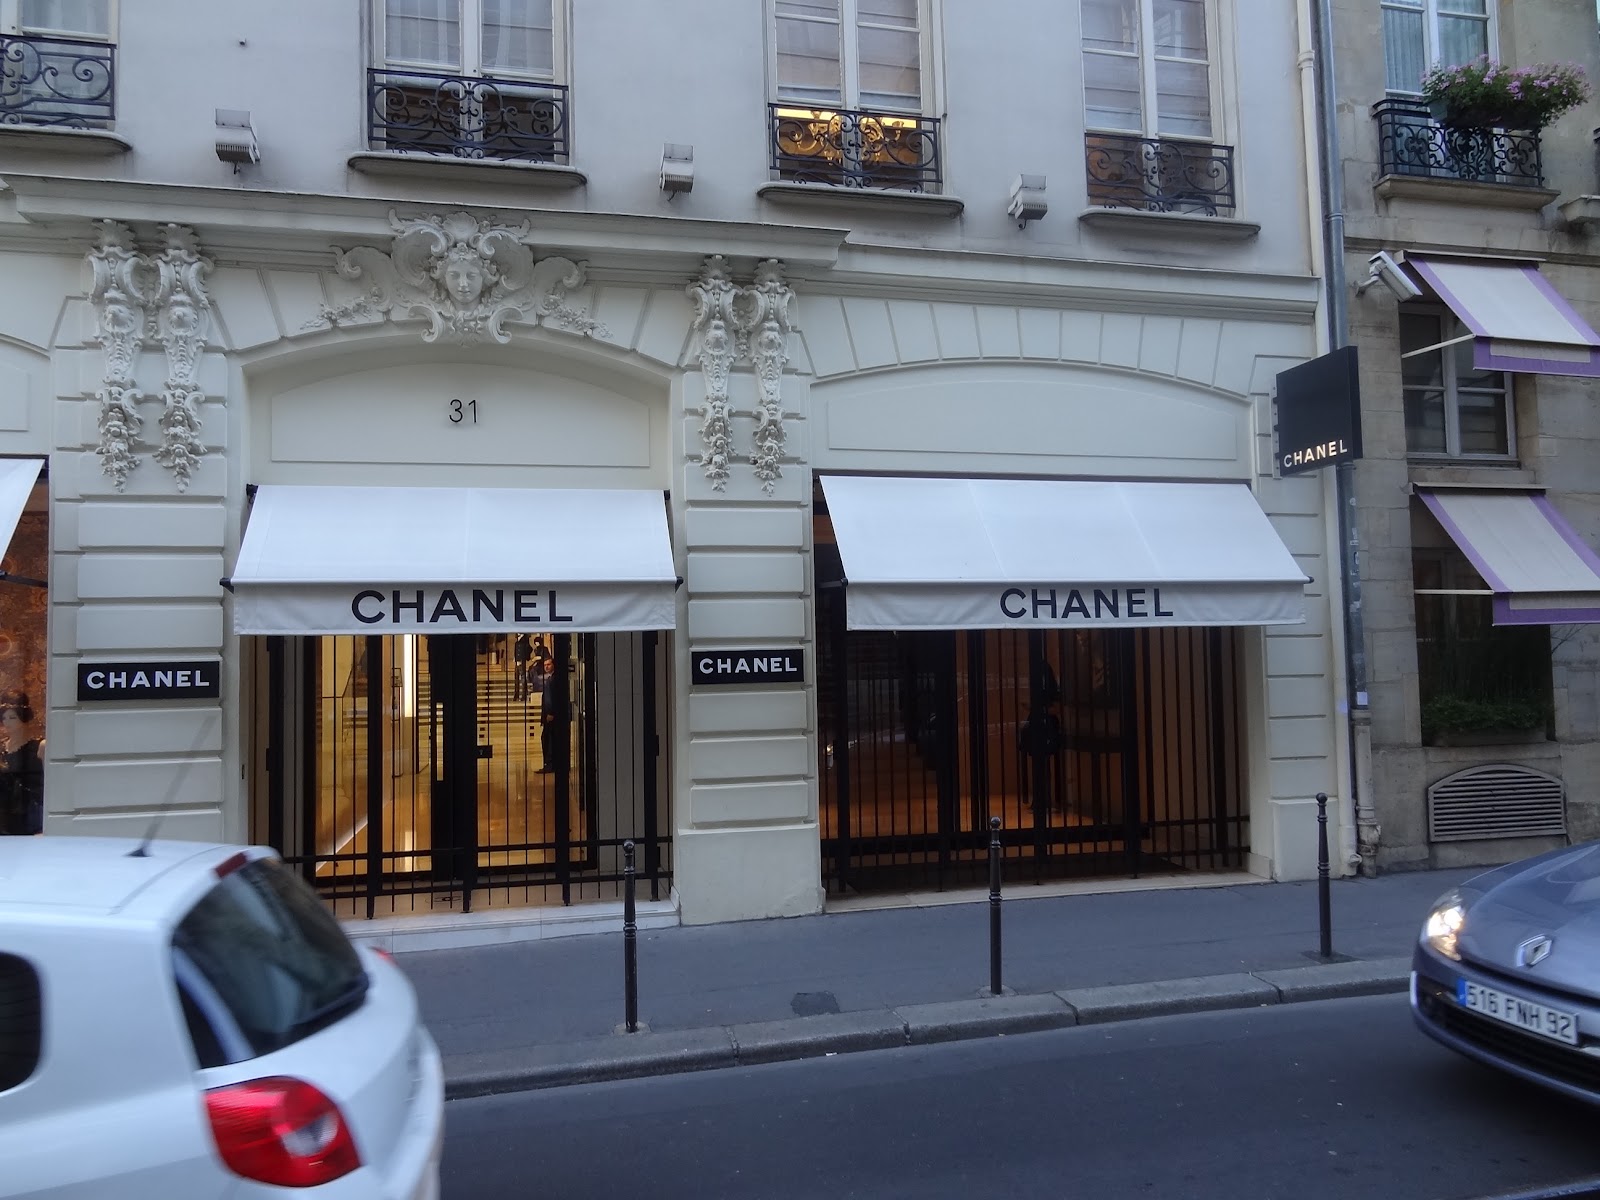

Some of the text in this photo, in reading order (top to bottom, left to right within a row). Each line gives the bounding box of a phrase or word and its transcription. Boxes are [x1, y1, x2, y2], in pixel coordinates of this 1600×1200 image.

[449, 399, 477, 423] 31
[1283, 439, 1348, 468] CHANEL
[351, 589, 573, 623] CHANEL
[1000, 588, 1174, 619] CHANEL
[86, 670, 210, 689] CHANEL
[699, 657, 798, 675] CHANEL
[1467, 985, 1572, 1039] 516 FNH 92
